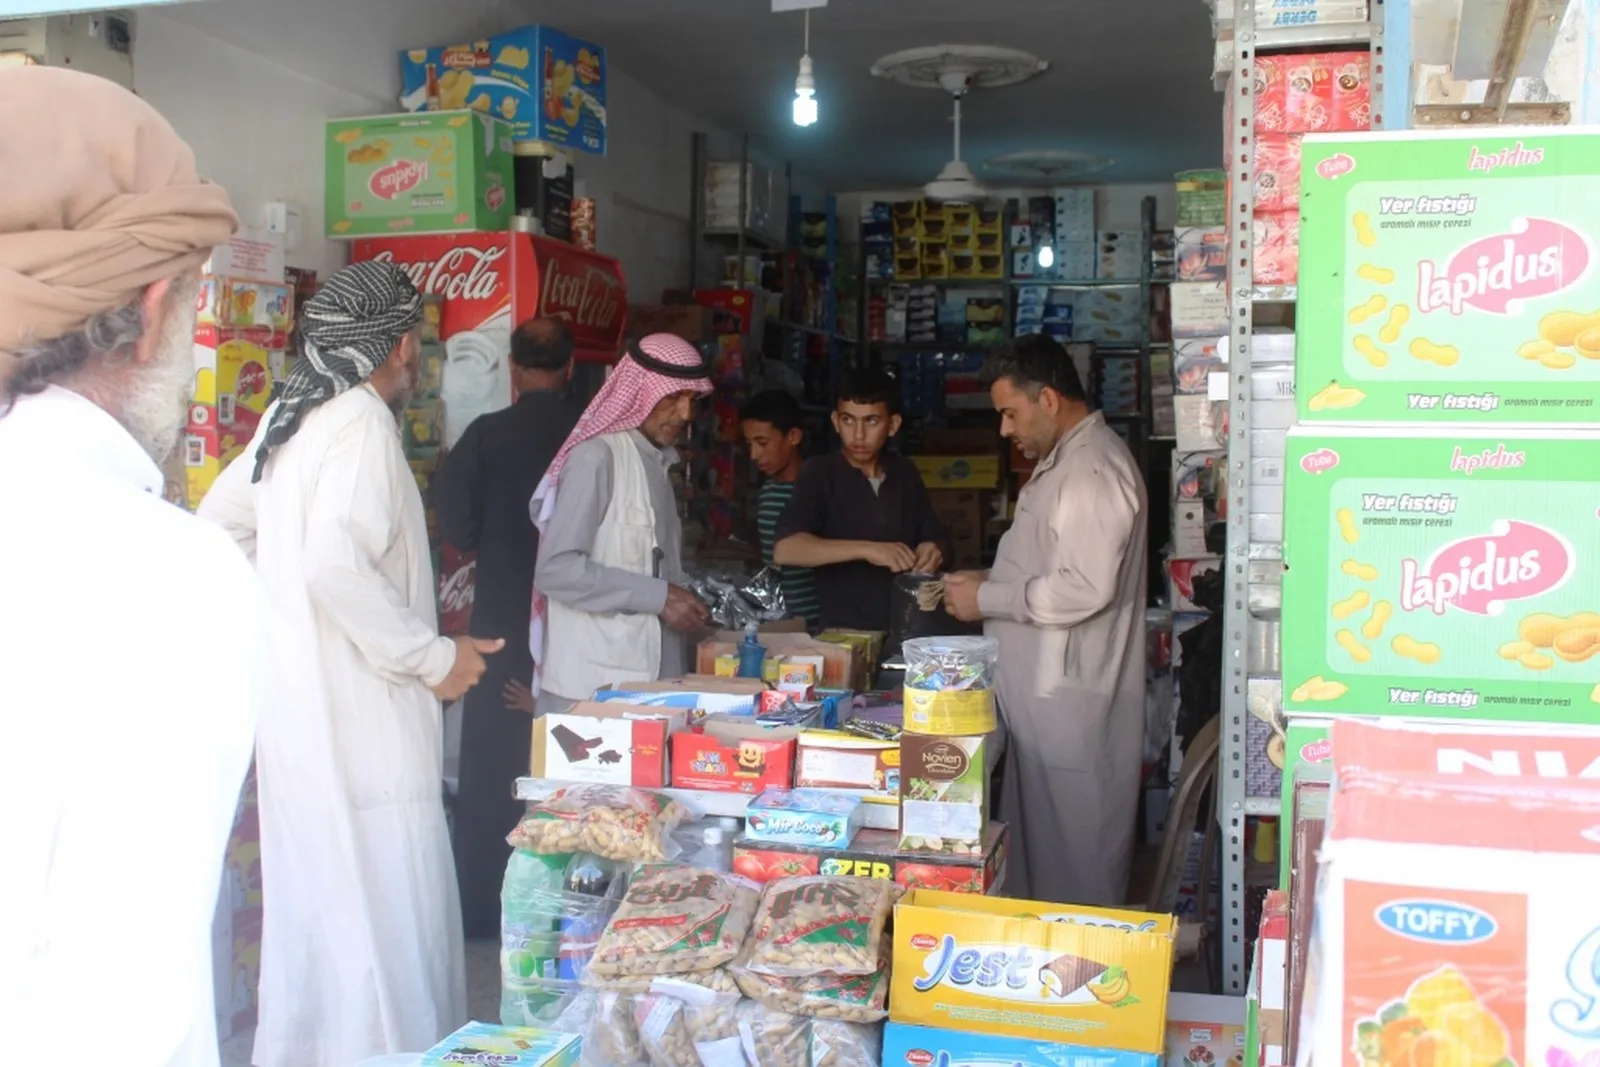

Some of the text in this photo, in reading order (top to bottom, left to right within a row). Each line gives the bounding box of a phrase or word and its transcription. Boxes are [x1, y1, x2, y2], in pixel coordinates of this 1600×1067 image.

[1273, 10, 1318, 26] DERBY
[1468, 141, 1544, 174] lapidus
[1379, 193, 1477, 216] Yer fıstığı
[1417, 237, 1561, 316] lapidus
[1407, 393, 1441, 410] Yer
[1443, 391, 1500, 411] fıstığı
[1451, 442, 1526, 475] lapidus
[1362, 493, 1458, 516] Yer fıstığı
[1401, 540, 1541, 615] lapidus
[1388, 687, 1422, 704] Yer
[1424, 687, 1480, 708] fıstığı
[1391, 905, 1481, 938] TOFFY
[913, 934, 1033, 992] Jest
